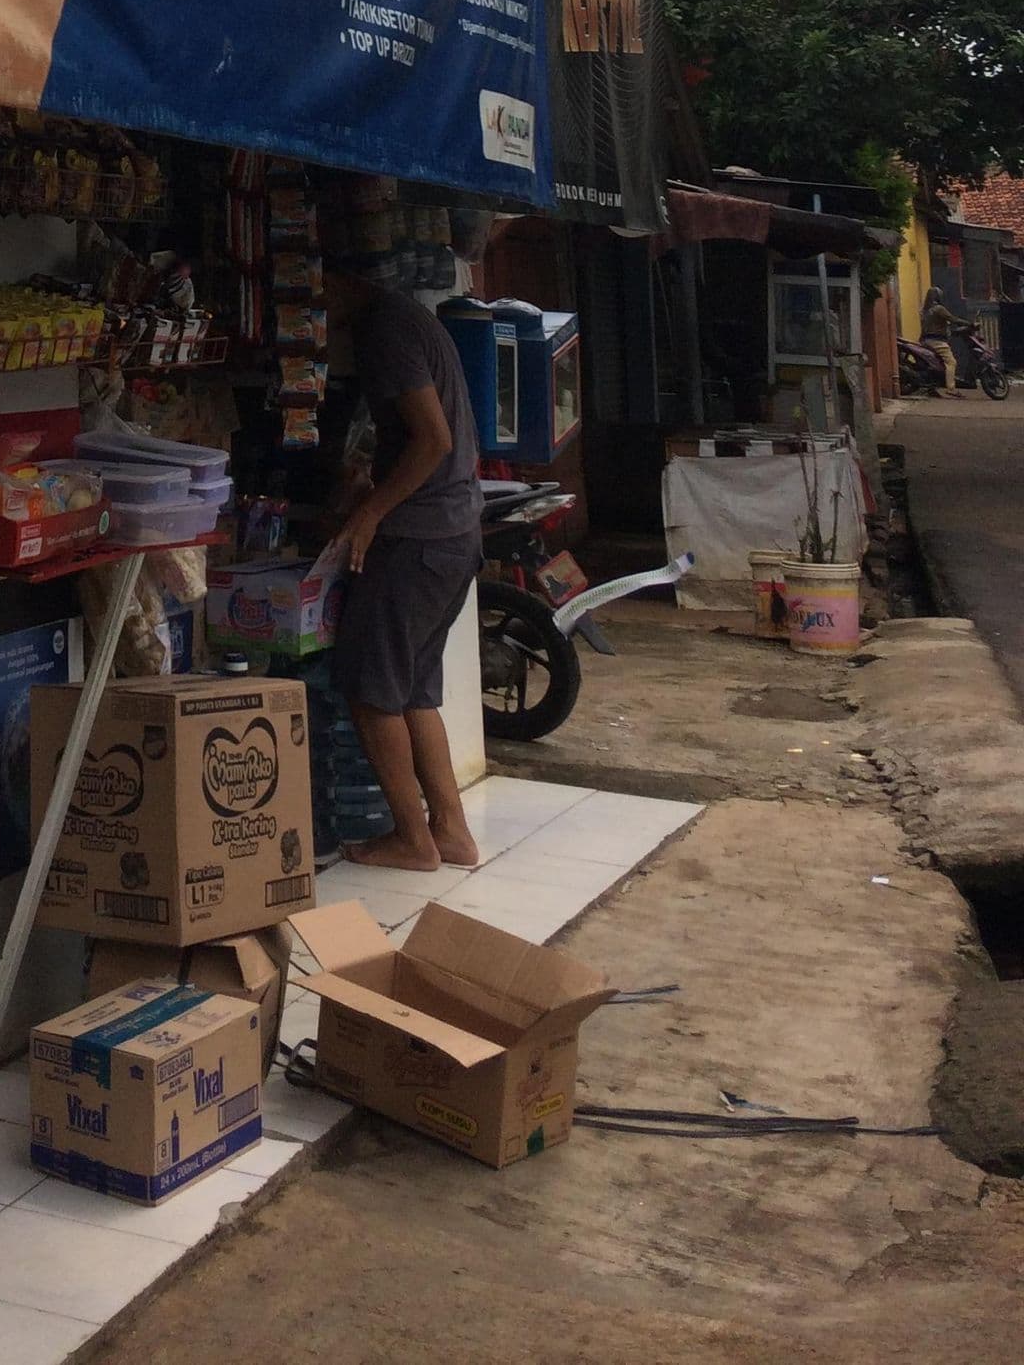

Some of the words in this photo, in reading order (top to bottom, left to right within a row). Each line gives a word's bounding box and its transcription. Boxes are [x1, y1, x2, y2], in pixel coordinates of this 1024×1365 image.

[347, 27, 374, 54] TOP
[374, 34, 391, 58] UP
[75, 765, 138, 796] amyPoko
[207, 742, 274, 791] MamyPoko
[227, 782, 258, 806] pants
[95, 818, 140, 845] Kering
[240, 812, 277, 840] Kering
[193, 1055, 224, 1108] Vixal
[66, 1092, 109, 1136] Vixal
